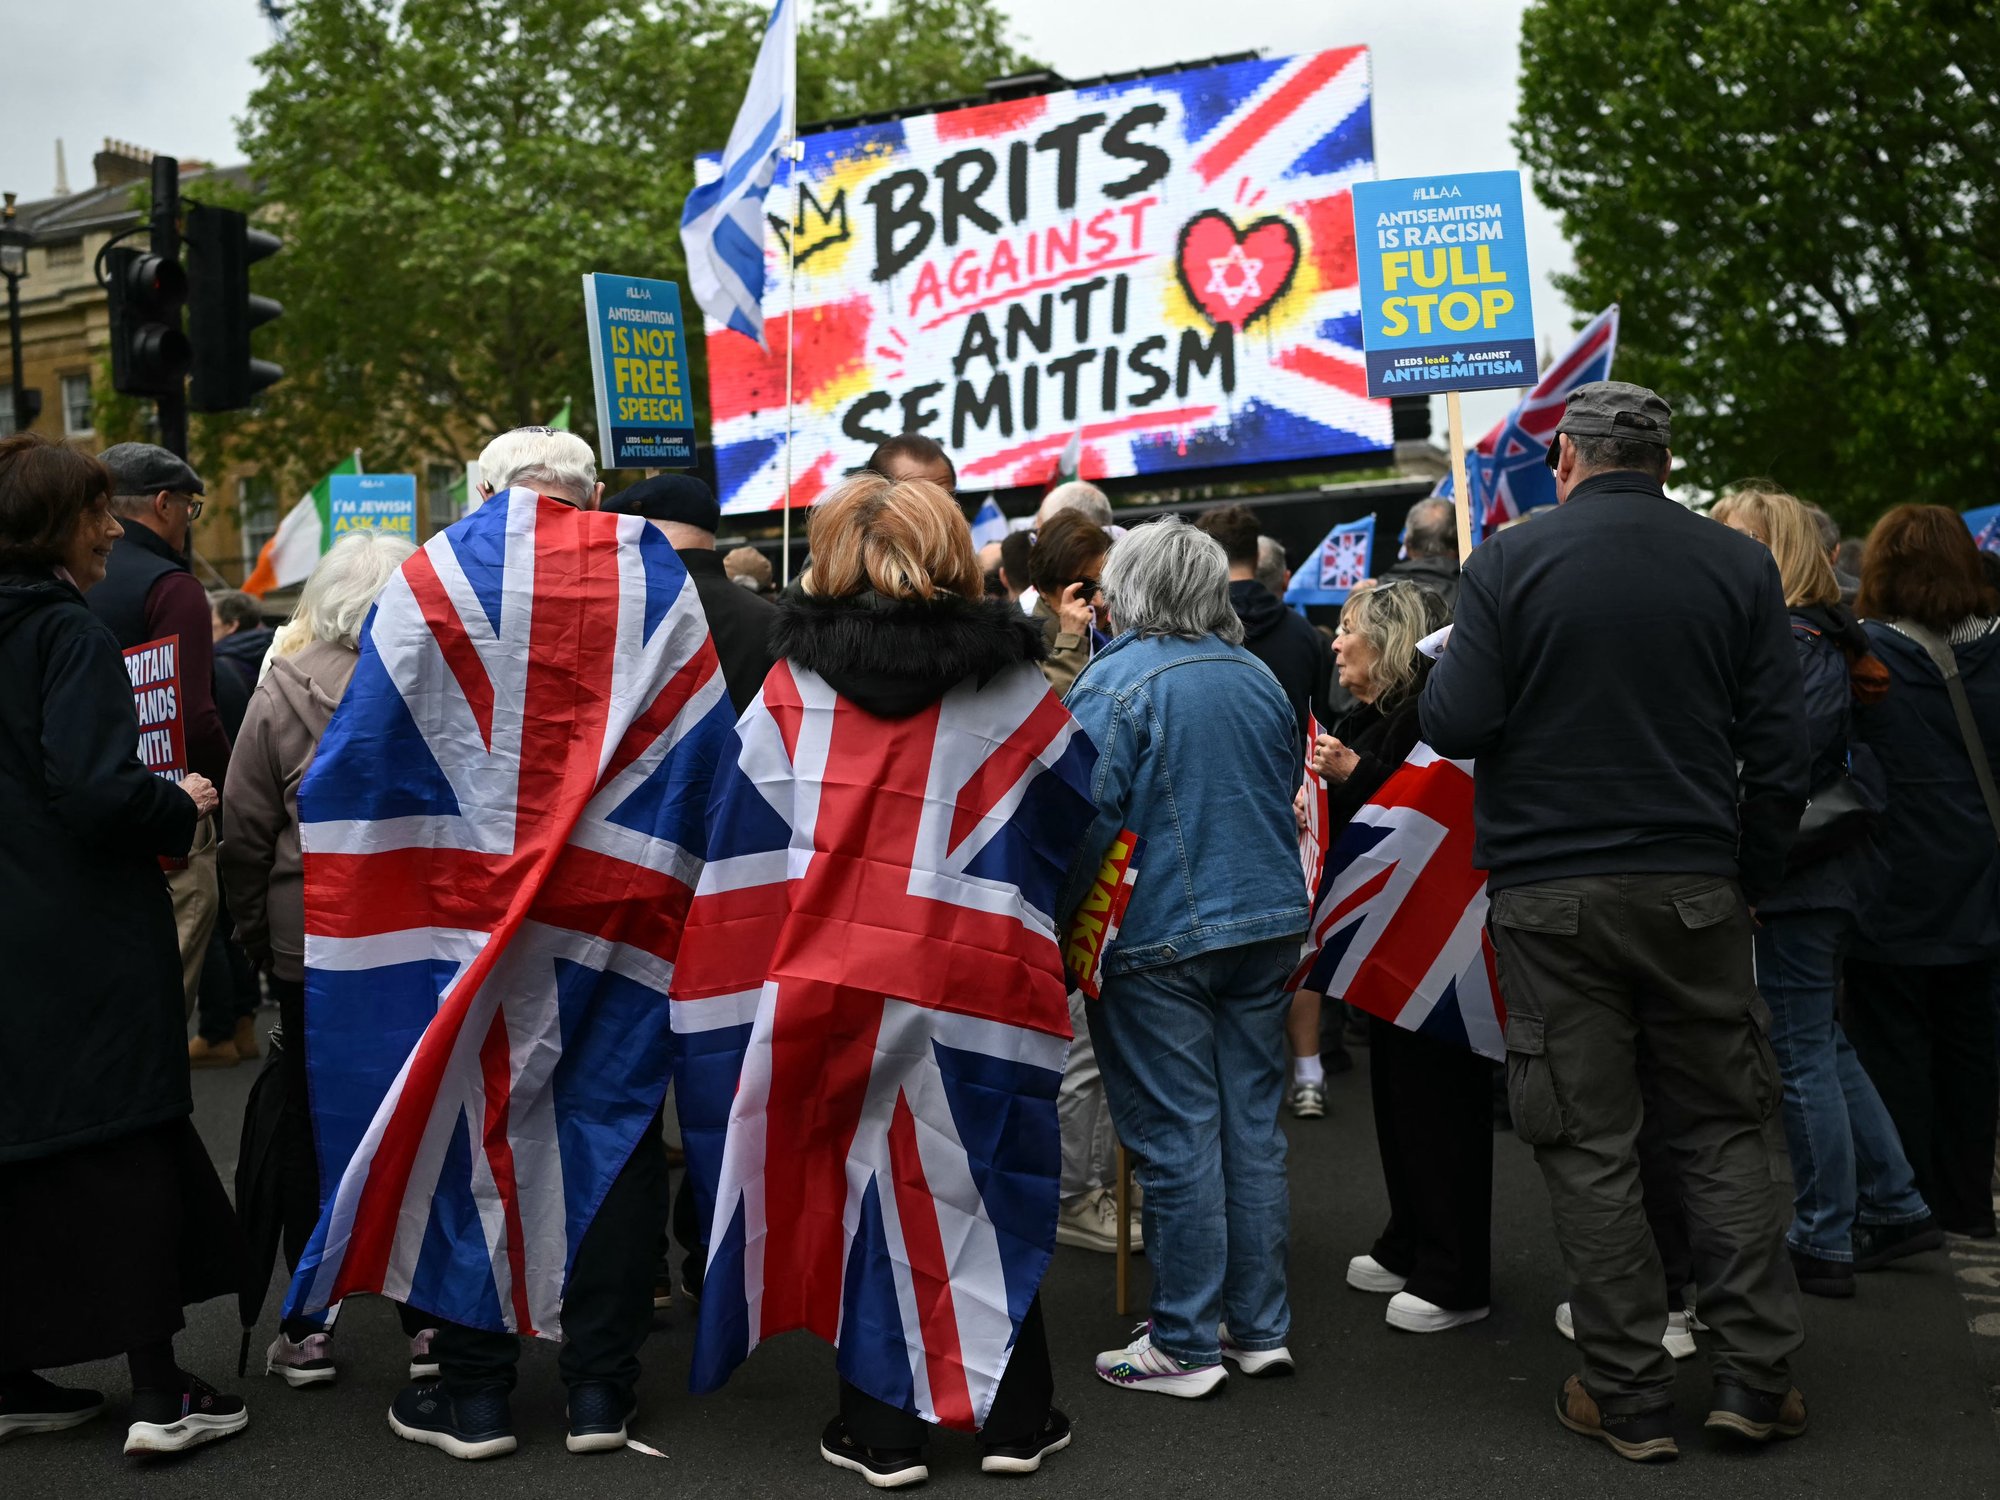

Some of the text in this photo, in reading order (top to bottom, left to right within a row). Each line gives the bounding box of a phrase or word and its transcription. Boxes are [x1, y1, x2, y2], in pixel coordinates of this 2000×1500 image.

[863, 103, 1171, 282] BRITS
[1413, 185, 1462, 200] #LLAA
[1376, 203, 1502, 228] ANTISEMITISM
[1378, 221, 1504, 249] IS RACISM
[908, 196, 1159, 317] AGAINST
[1381, 244, 1507, 291] FULL
[608, 307, 675, 325] ANTISEMITISM
[952, 272, 1129, 376] ANTI
[1381, 289, 1515, 337] STOP
[610, 326, 676, 357] IS NOT
[1382, 359, 1523, 383] ANTISEMITISM
[1394, 350, 1511, 367] LEEDS leads AGAINST
[613, 357, 682, 395] FREE
[842, 320, 1236, 449] SEMITISM
[618, 397, 684, 422] SPEECH
[620, 445, 690, 457] ANTISEMITISM
[333, 499, 412, 514] I'M JEWISH
[335, 515, 411, 532] ASK ME
[134, 685, 177, 726] TANDS
[1067, 840, 1129, 981] MAKE
